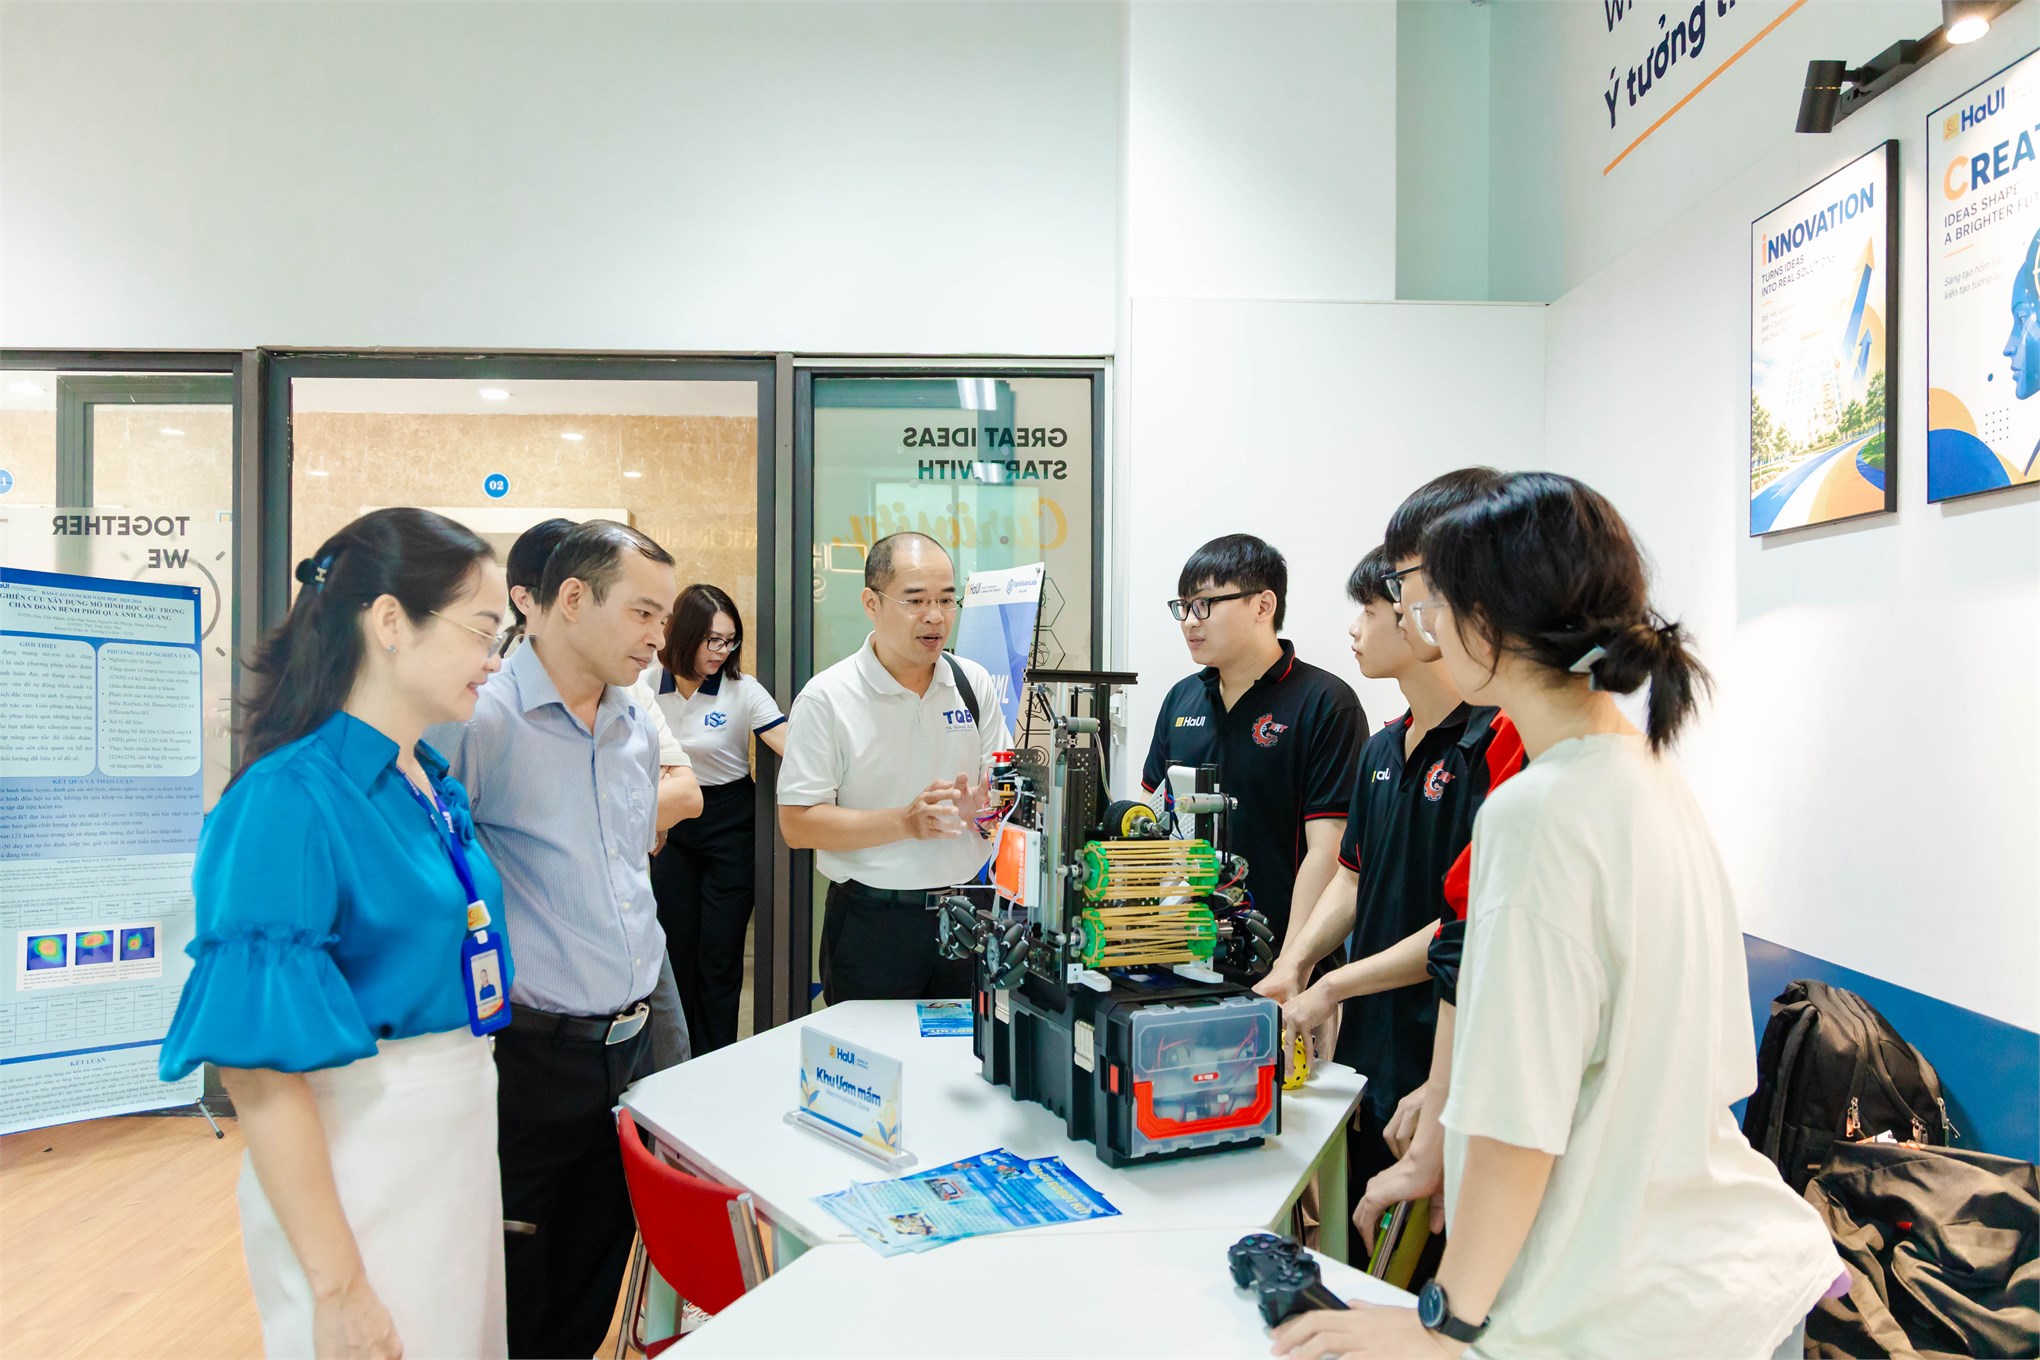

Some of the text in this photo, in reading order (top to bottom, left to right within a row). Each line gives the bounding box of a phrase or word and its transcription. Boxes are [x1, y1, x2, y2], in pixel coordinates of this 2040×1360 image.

[1604, 14, 1705, 129] Ý tưởng
[1961, 86, 2005, 132] HaUI
[1943, 123, 2040, 200] CREA
[1944, 183, 2019, 228] IDEAS SHAPE
[1944, 232, 1952, 246] A
[1955, 204, 2014, 240] BRIGHTER
[1762, 255, 1804, 284] TURNS IDEAS
[1761, 282, 1777, 297] INTO
[1778, 273, 1795, 289] REAL
[489, 480, 504, 490] 02
[0, 592, 26, 600] GHIÊN
[943, 709, 973, 724] TQB
[1183, 716, 1206, 727] HaUI
[837, 1047, 855, 1065] HaUI
[816, 1067, 835, 1088] Khu
